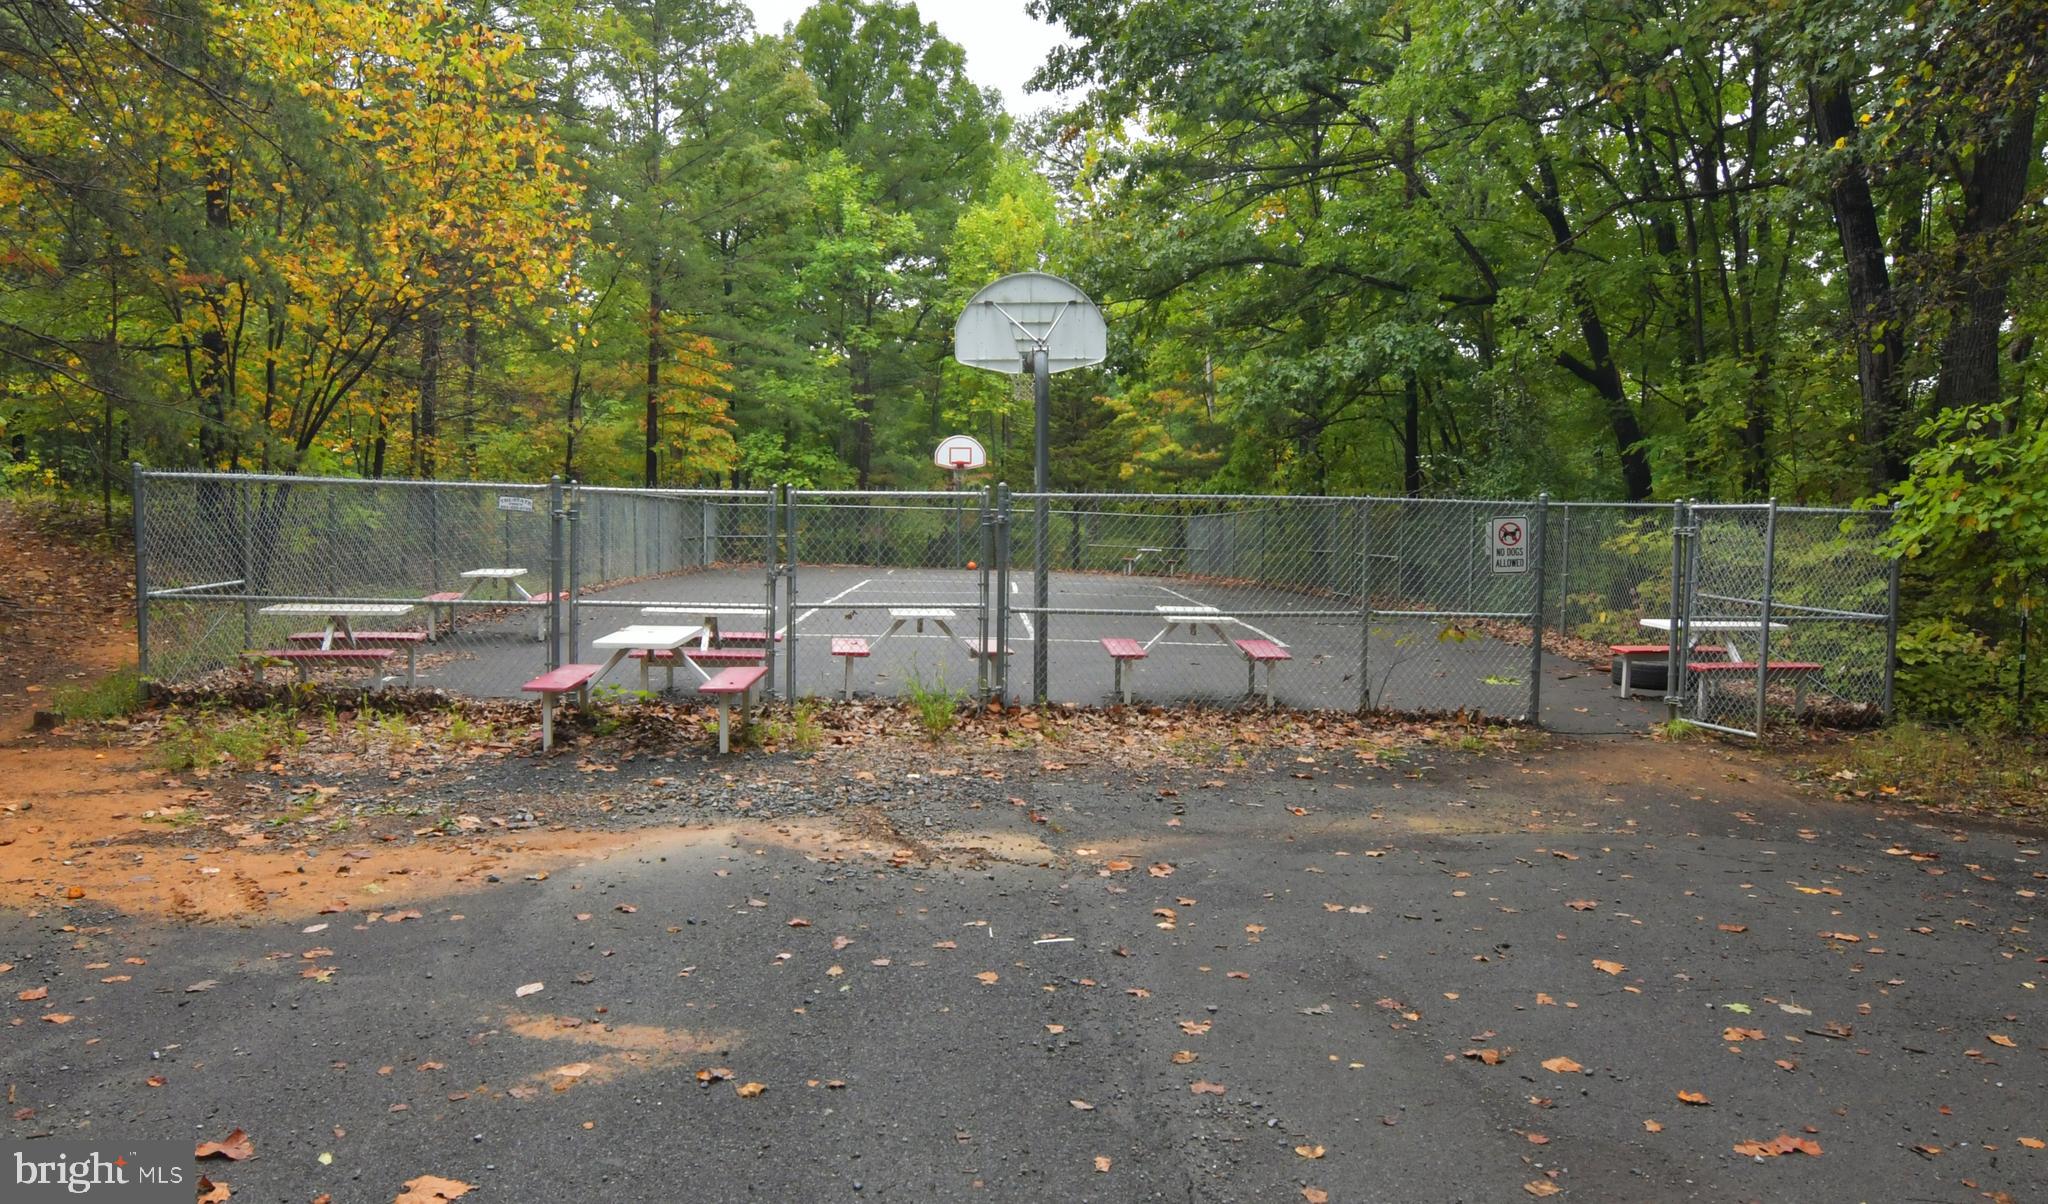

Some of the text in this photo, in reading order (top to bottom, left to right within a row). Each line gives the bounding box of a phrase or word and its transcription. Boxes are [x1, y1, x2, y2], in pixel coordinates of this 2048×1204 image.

[1496, 548, 1524, 556] NO DOGS
[1495, 559, 1525, 568] ALLOWED
